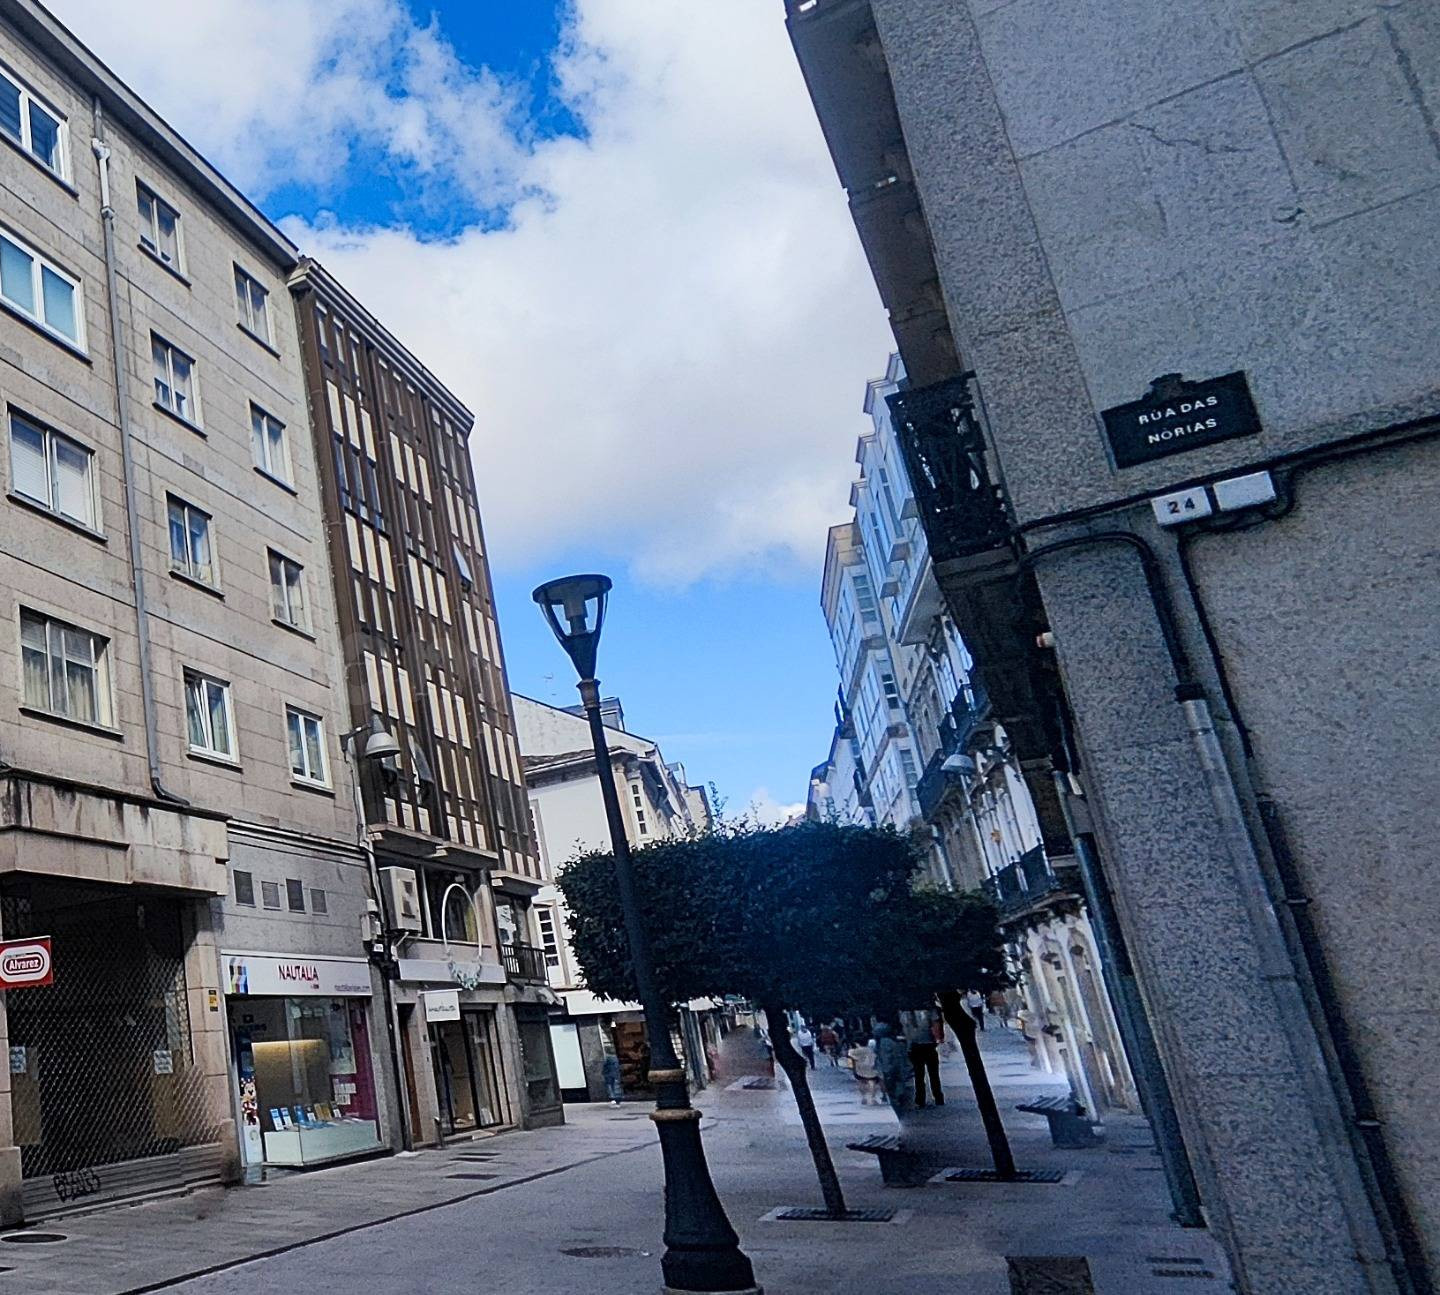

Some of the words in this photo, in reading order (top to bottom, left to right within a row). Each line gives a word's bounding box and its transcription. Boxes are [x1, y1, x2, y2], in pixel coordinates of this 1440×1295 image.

[1181, 396, 1218, 413] DAS
[1168, 498, 1195, 514] 24
[9, 958, 40, 970] Alvarez
[278, 964, 320, 982] NAUTALIA
